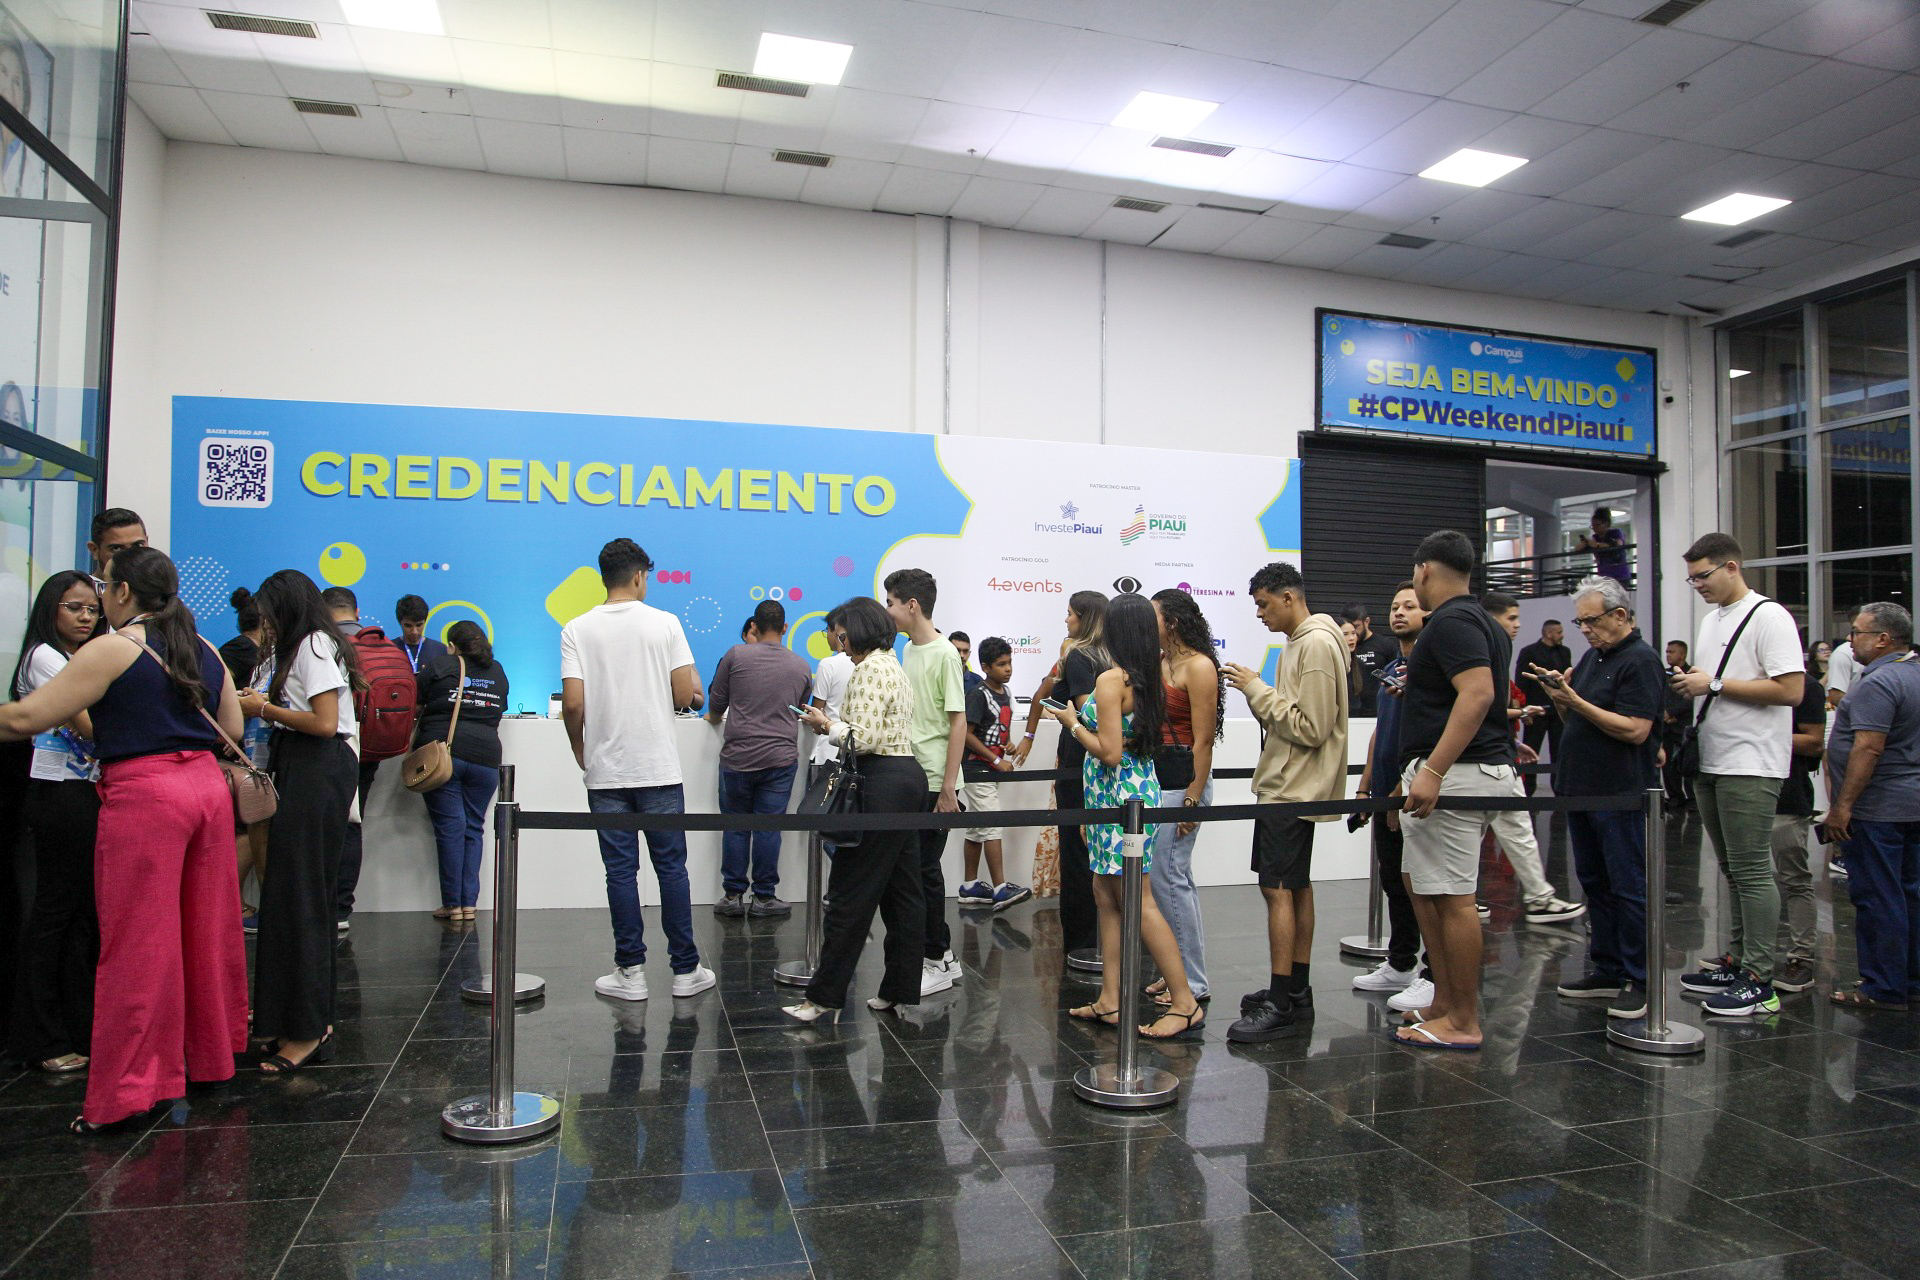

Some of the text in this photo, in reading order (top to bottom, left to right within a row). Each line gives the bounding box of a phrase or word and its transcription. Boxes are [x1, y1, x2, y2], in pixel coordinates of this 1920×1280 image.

[1485, 345, 1523, 358] Campus
[1366, 359, 1618, 409] SEJA BEM-VINDO
[1357, 393, 1625, 442] #CPWeekendPiauí
[300, 451, 897, 517] CREDENCIAMENTO
[1034, 521, 1104, 535] InvestePiauí
[988, 577, 1063, 593] 4.events
[1711, 973, 1735, 981] FILA
